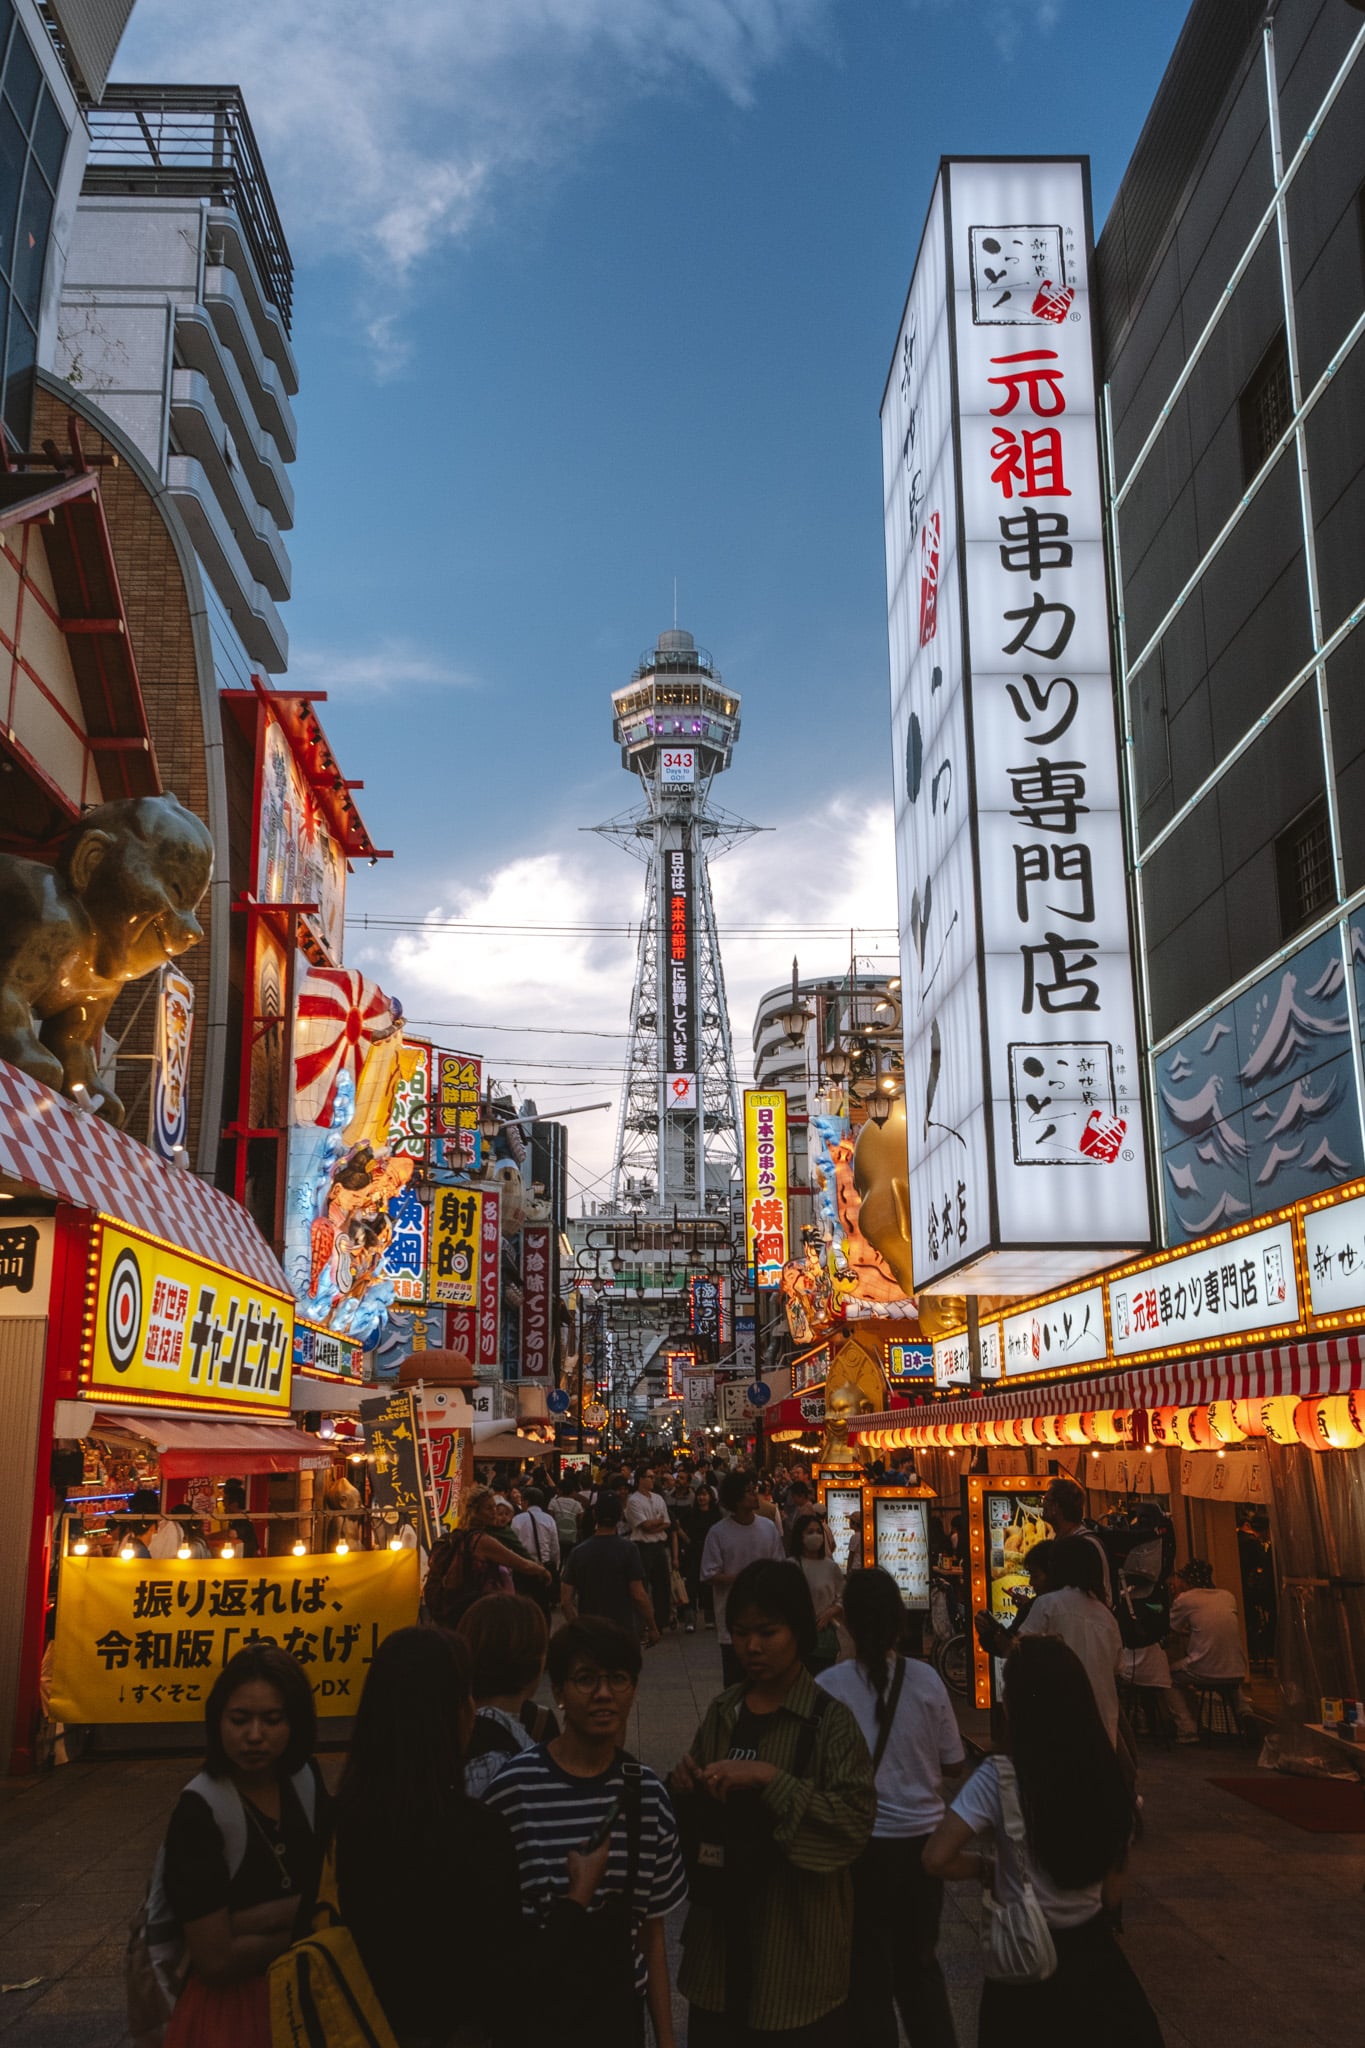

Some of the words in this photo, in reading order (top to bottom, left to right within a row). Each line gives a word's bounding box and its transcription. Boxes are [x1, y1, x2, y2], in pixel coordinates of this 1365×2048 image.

[988, 349, 1102, 1014] 元祖串カツ専門店
[663, 753, 693, 767] 343
[671, 852, 687, 1070] 日立は「未来の都市」に協賛しています
[443, 1058, 478, 1089] 24
[757, 1108, 776, 1197] 日本一の串かつ
[438, 1192, 477, 1281] 射的
[483, 1201, 497, 1241] 名物
[751, 1199, 784, 1266] 横綱
[435, 1289, 472, 1302] チャンピオン
[1313, 1236, 1365, 1288] 新世
[152, 1279, 189, 1324] 新世界
[481, 1272, 495, 1356] てっちり
[525, 1252, 546, 1372] 珍味てっちり
[1132, 1259, 1259, 1333] 元祖串カツ専門店
[144, 1325, 183, 1367] 遊技場
[189, 1289, 288, 1392] チャンピオン
[133, 1575, 343, 1619] 振り返れば、
